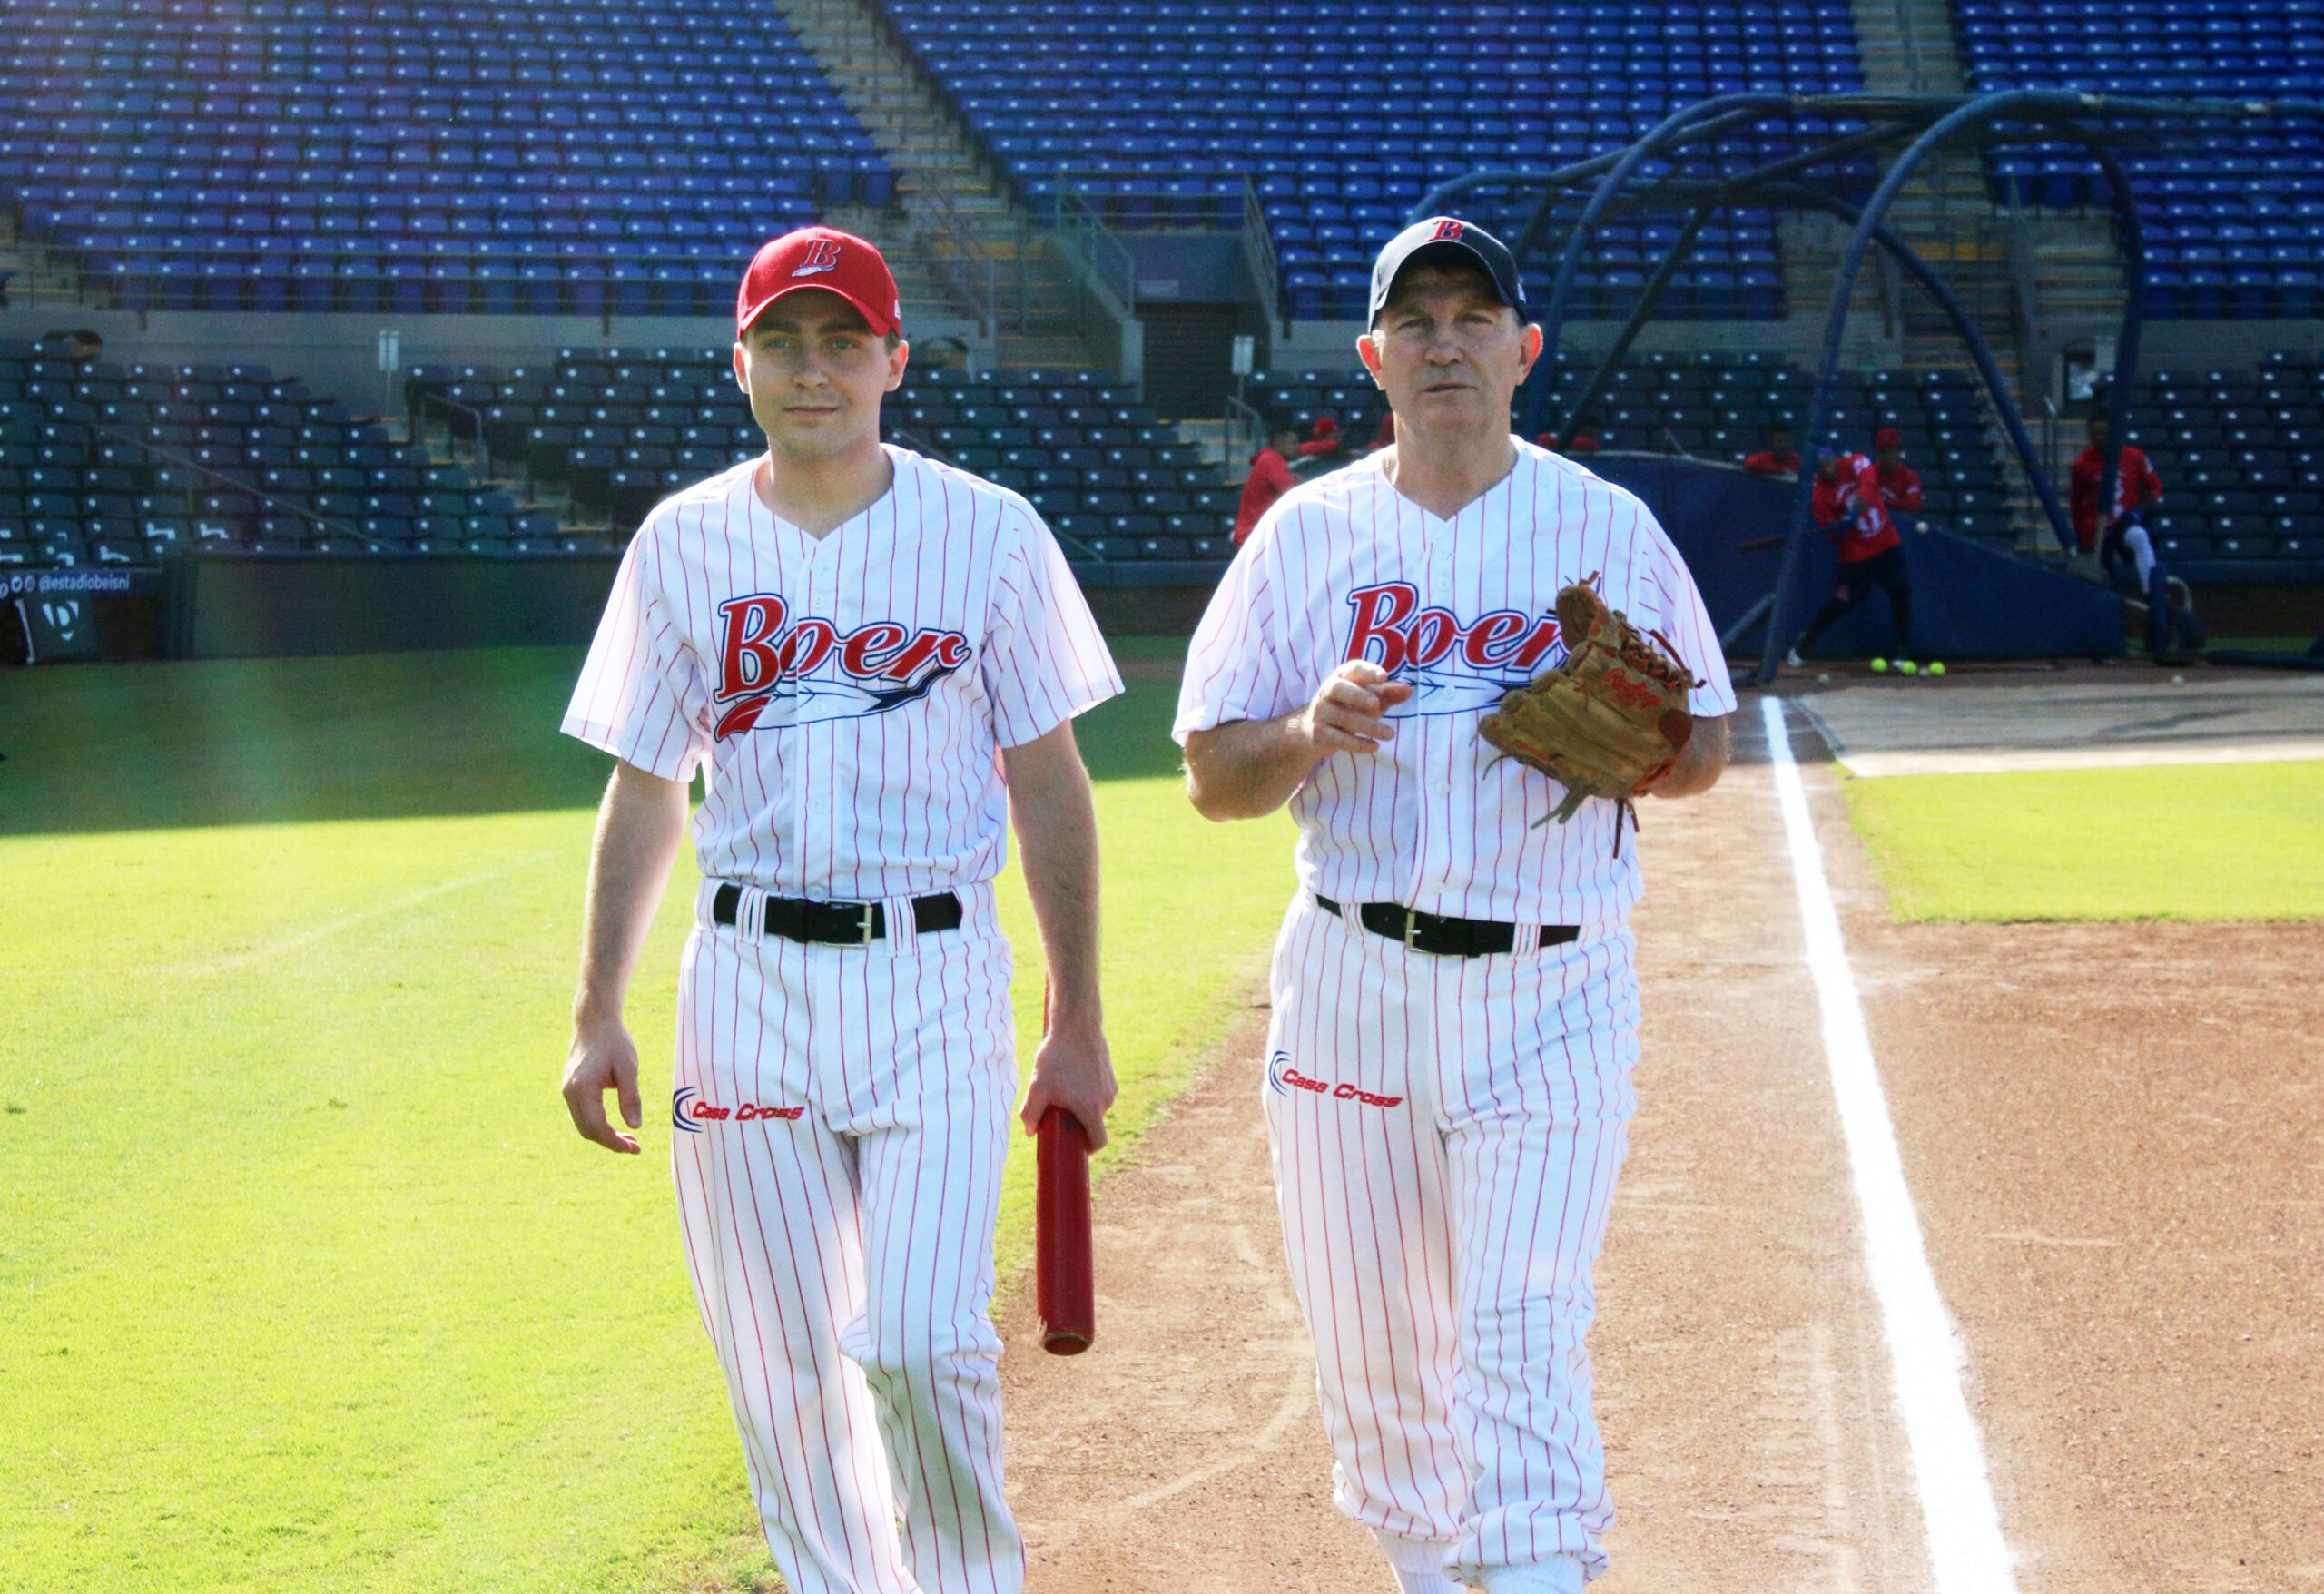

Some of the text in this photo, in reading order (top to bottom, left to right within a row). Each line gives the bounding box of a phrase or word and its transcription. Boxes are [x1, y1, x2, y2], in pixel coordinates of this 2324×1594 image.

[1426, 220, 1464, 242] B
[799, 238, 841, 271] B
[714, 592, 972, 704] Boer
[1282, 1068, 1403, 1107] Casa Cross
[692, 1101, 805, 1121] Casa Cross
